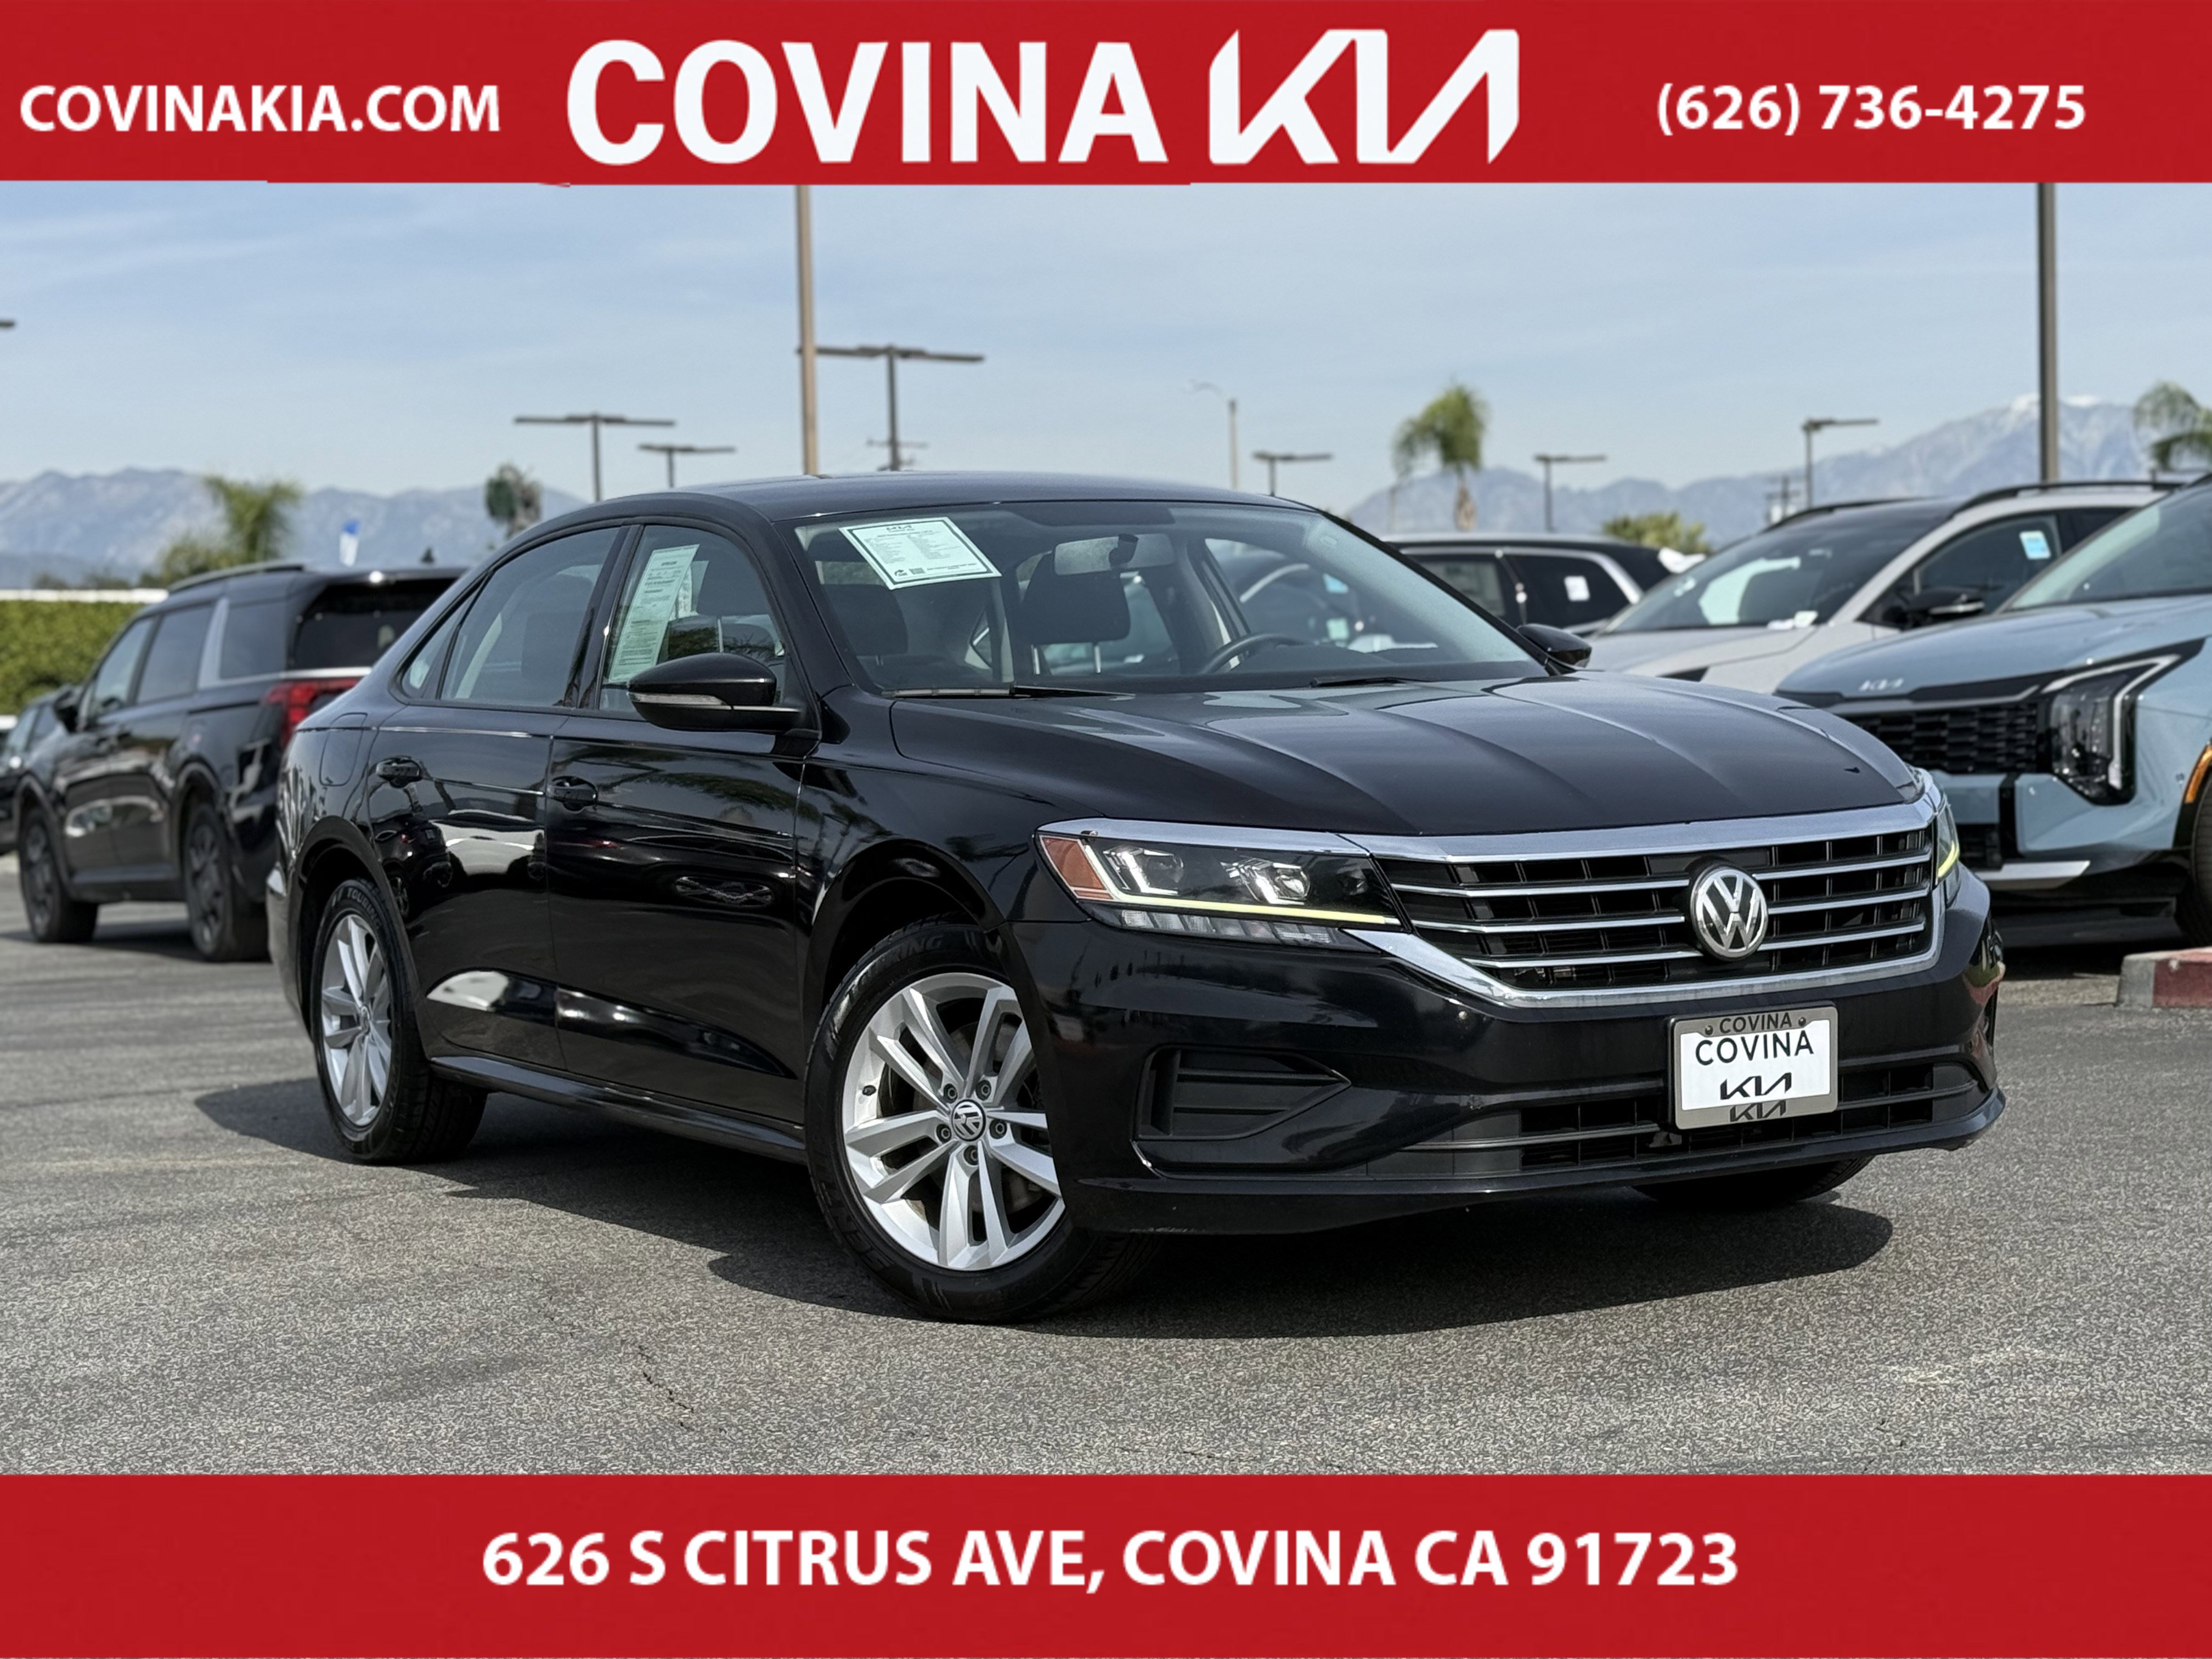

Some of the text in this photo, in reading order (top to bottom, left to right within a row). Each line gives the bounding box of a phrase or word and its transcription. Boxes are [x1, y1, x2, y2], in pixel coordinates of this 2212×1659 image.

[1719, 1012, 1792, 1035] COVINA
[1695, 1030, 1815, 1066] COVINA
[1719, 1071, 1792, 1101] KIA
[1729, 1099, 1787, 1122] KIA
